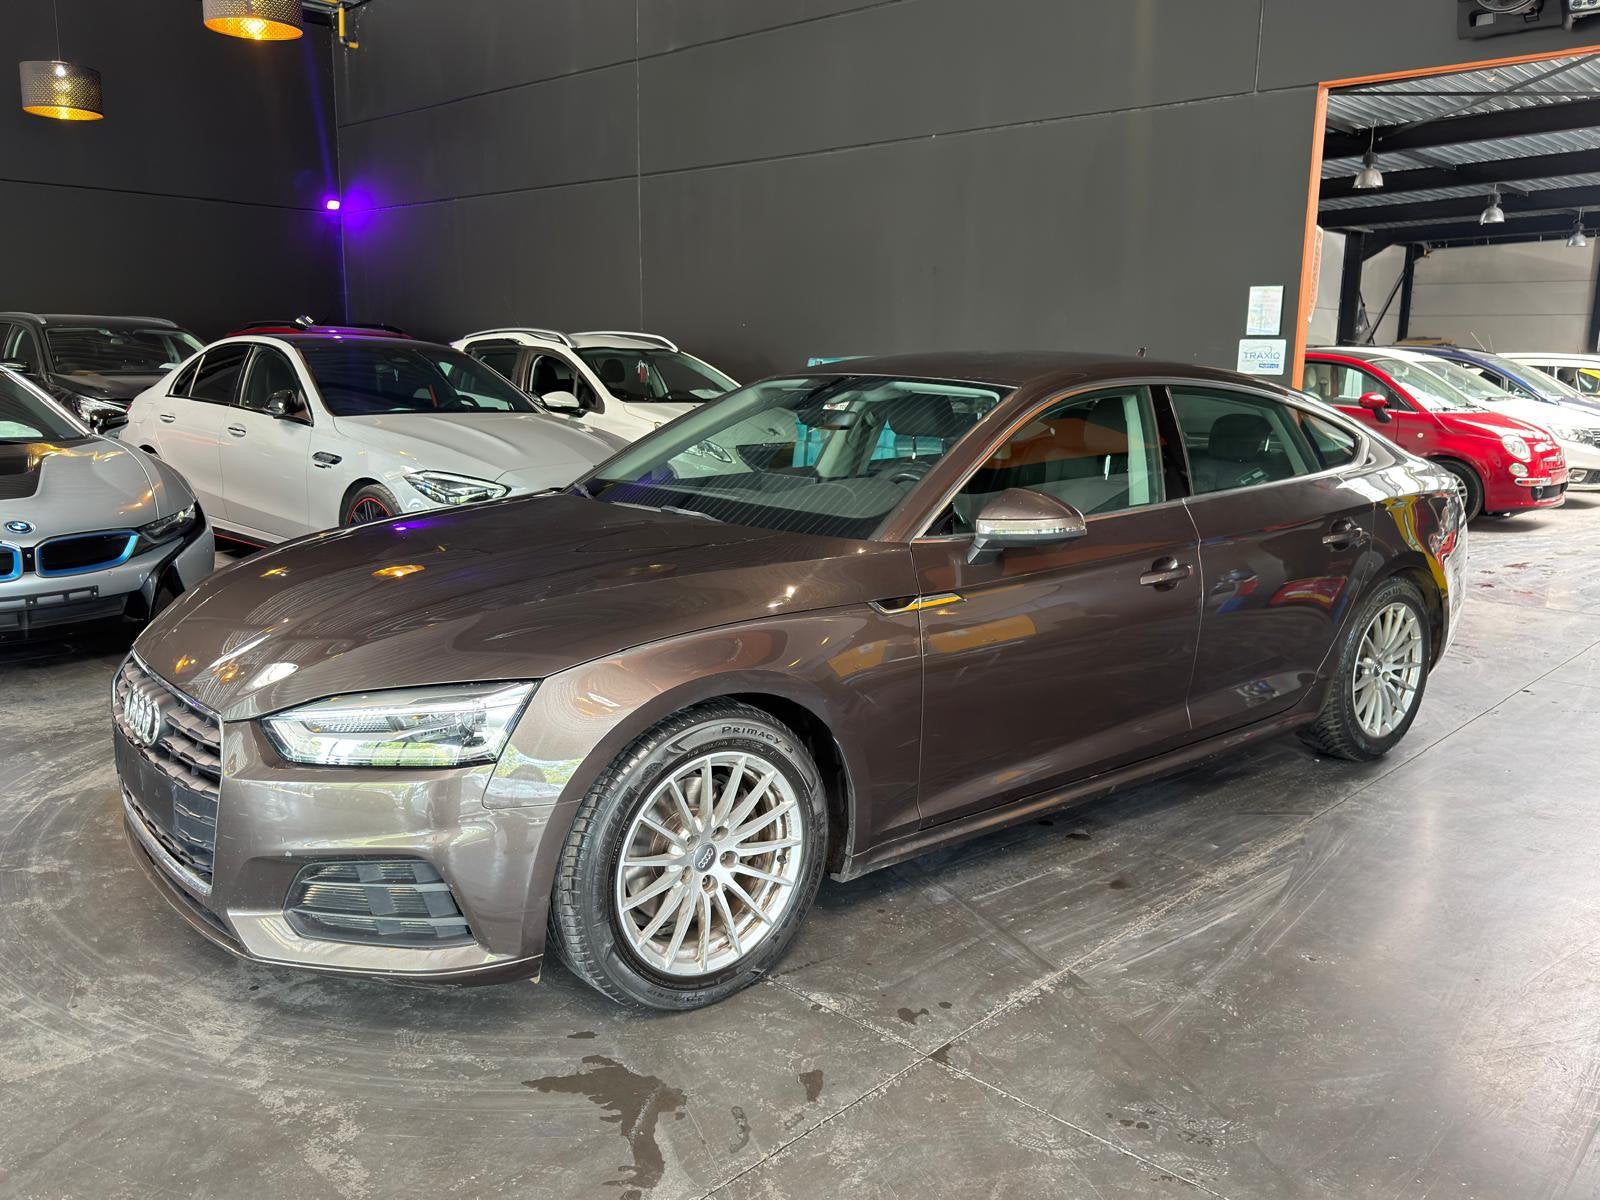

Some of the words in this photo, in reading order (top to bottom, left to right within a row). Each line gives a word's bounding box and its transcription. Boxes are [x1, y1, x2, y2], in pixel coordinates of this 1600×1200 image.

[1243, 351, 1280, 360] TRAXIO
[721, 726, 782, 744] PRIMACY
[784, 744, 794, 754] 3
